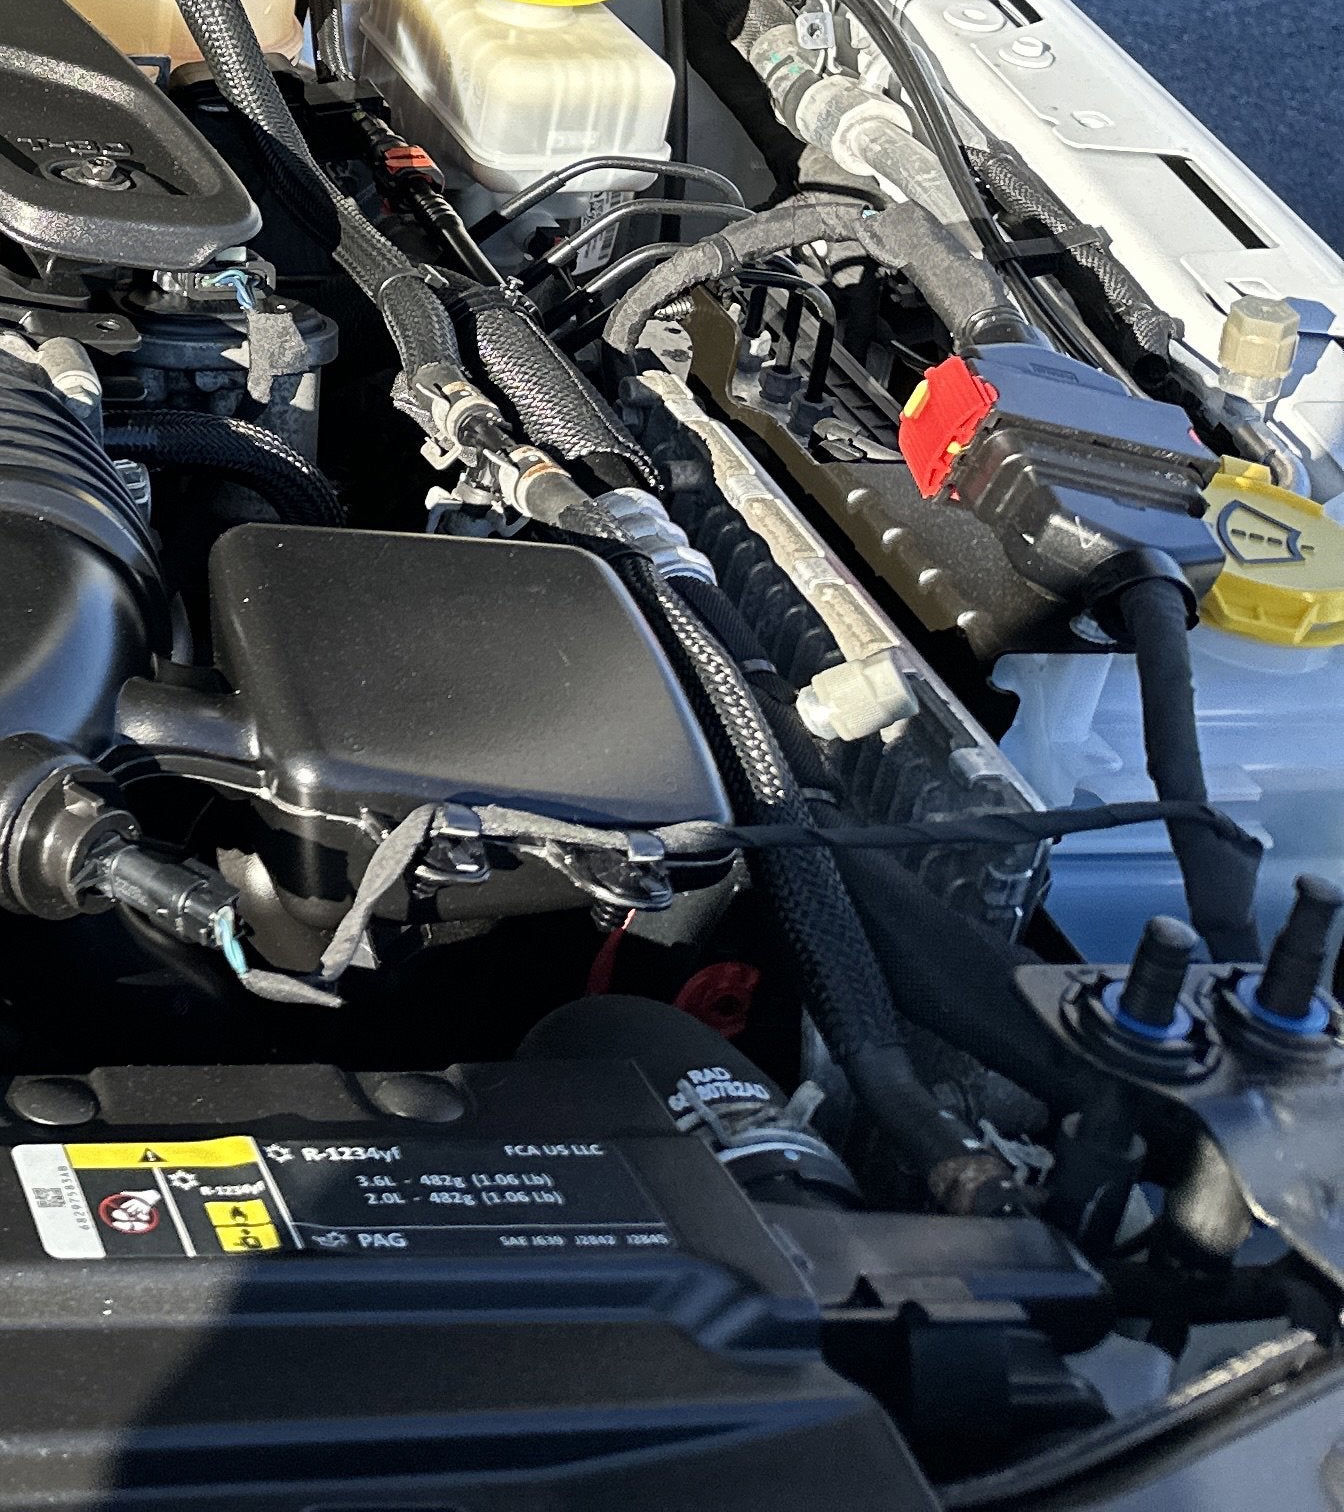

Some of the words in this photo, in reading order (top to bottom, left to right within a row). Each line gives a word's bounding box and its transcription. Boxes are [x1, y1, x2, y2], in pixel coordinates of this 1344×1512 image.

[686, 1066, 732, 1085] RAD
[300, 1145, 402, 1164] R-1234yf
[504, 1144, 541, 1157] FCA
[542, 1144, 569, 1156] US
[570, 1143, 605, 1156] LLC
[355, 1174, 397, 1188] 3.6L
[419, 1174, 467, 1189] 482g
[473, 1173, 520, 1188] (1.06
[365, 1192, 406, 1206] 2.0L
[429, 1191, 476, 1207] 482g
[481, 1191, 530, 1206] (1.06
[357, 1232, 408, 1248] PAG
[498, 1235, 529, 1247] SAE
